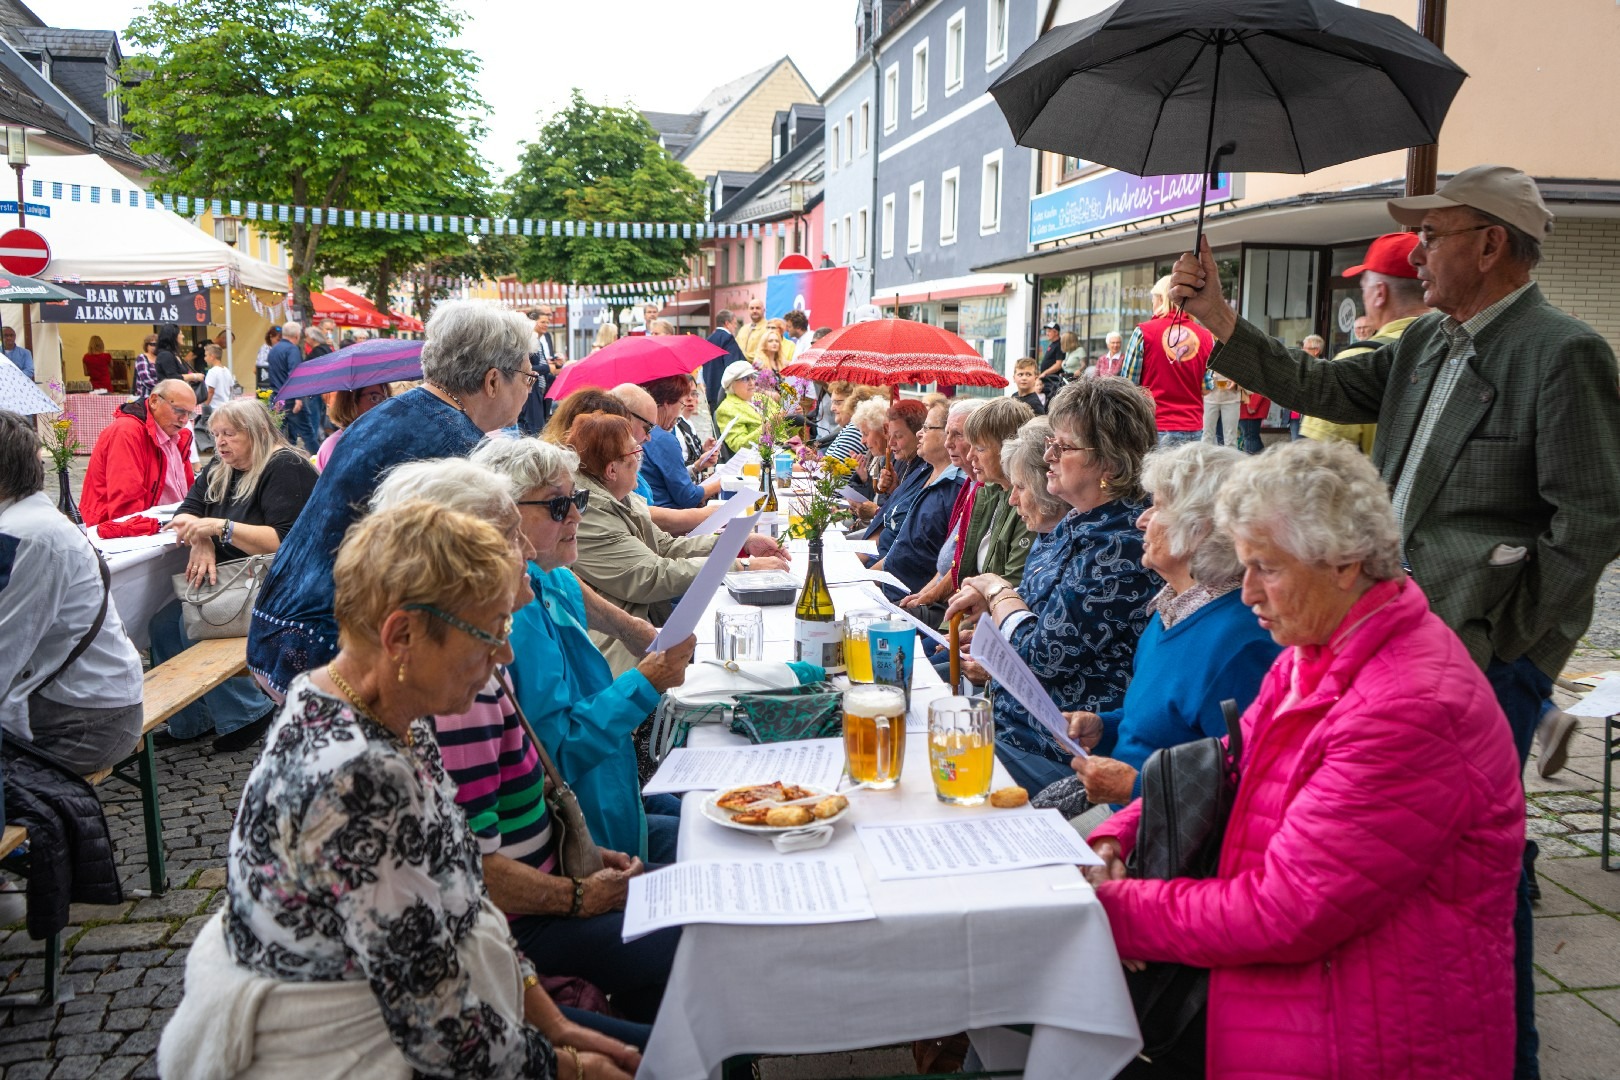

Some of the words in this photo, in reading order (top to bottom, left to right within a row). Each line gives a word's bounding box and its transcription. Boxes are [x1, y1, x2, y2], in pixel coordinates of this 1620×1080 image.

[86, 289, 118, 303] BAR
[123, 289, 165, 304] WETO
[75, 304, 154, 320] ALEŠOVKA
[159, 304, 179, 321] AŠ
